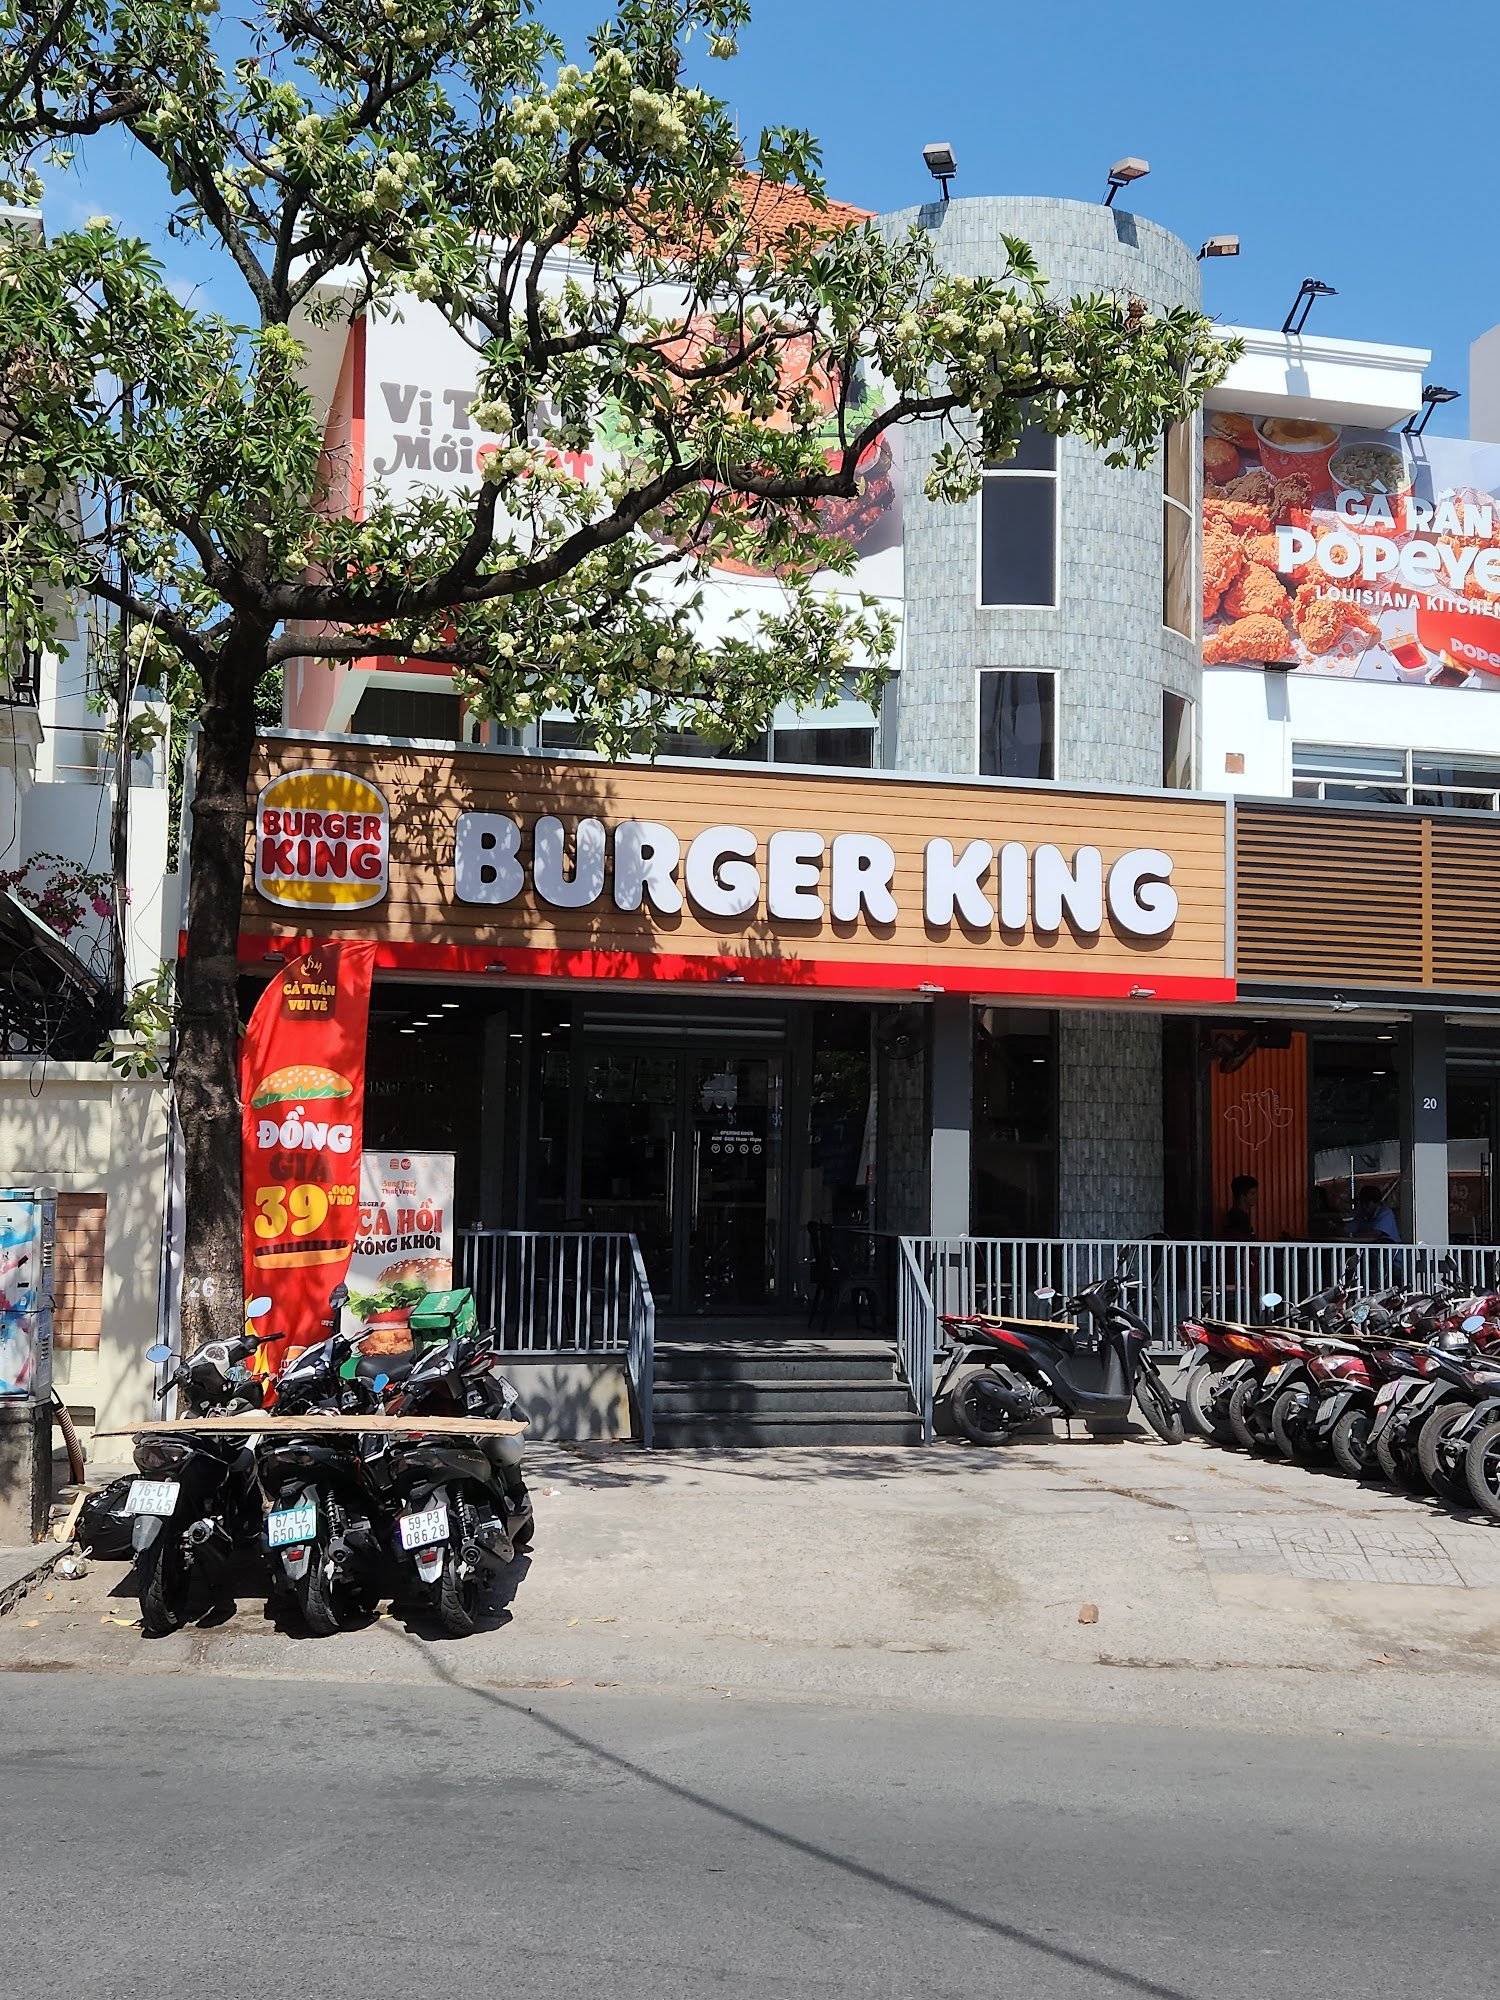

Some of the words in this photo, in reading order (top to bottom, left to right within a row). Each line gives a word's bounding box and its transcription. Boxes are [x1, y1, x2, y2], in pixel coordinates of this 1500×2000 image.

[373, 433, 474, 475] Mới
[1336, 479, 1396, 529] GÀ
[1403, 488, 1493, 539] RÁN
[1315, 585, 1421, 610] LOUISIANA
[263, 810, 382, 841] BURGER
[262, 838, 382, 879] KING
[454, 811, 899, 924] BURGER
[923, 838, 1179, 935] KING
[288, 999, 311, 1011] VUI
[1423, 1097, 1437, 1109] 20
[256, 1105, 353, 1153] ĐỒNG
[328, 1194, 353, 1206] VND
[254, 1183, 329, 1239] 39
[358, 1201, 391, 1236] CÁ
[397, 1198, 443, 1235] HỒI
[400, 1231, 441, 1251] KHÓI
[189, 1276, 215, 1297] 26
[138, 1483, 171, 1497] 76-C1
[130, 1497, 173, 1512] 015.45
[275, 1510, 308, 1528] 67-L2
[408, 1511, 440, 1530] 59-P3
[272, 1523, 313, 1543] 650.12
[406, 1524, 446, 1546] 086.28
